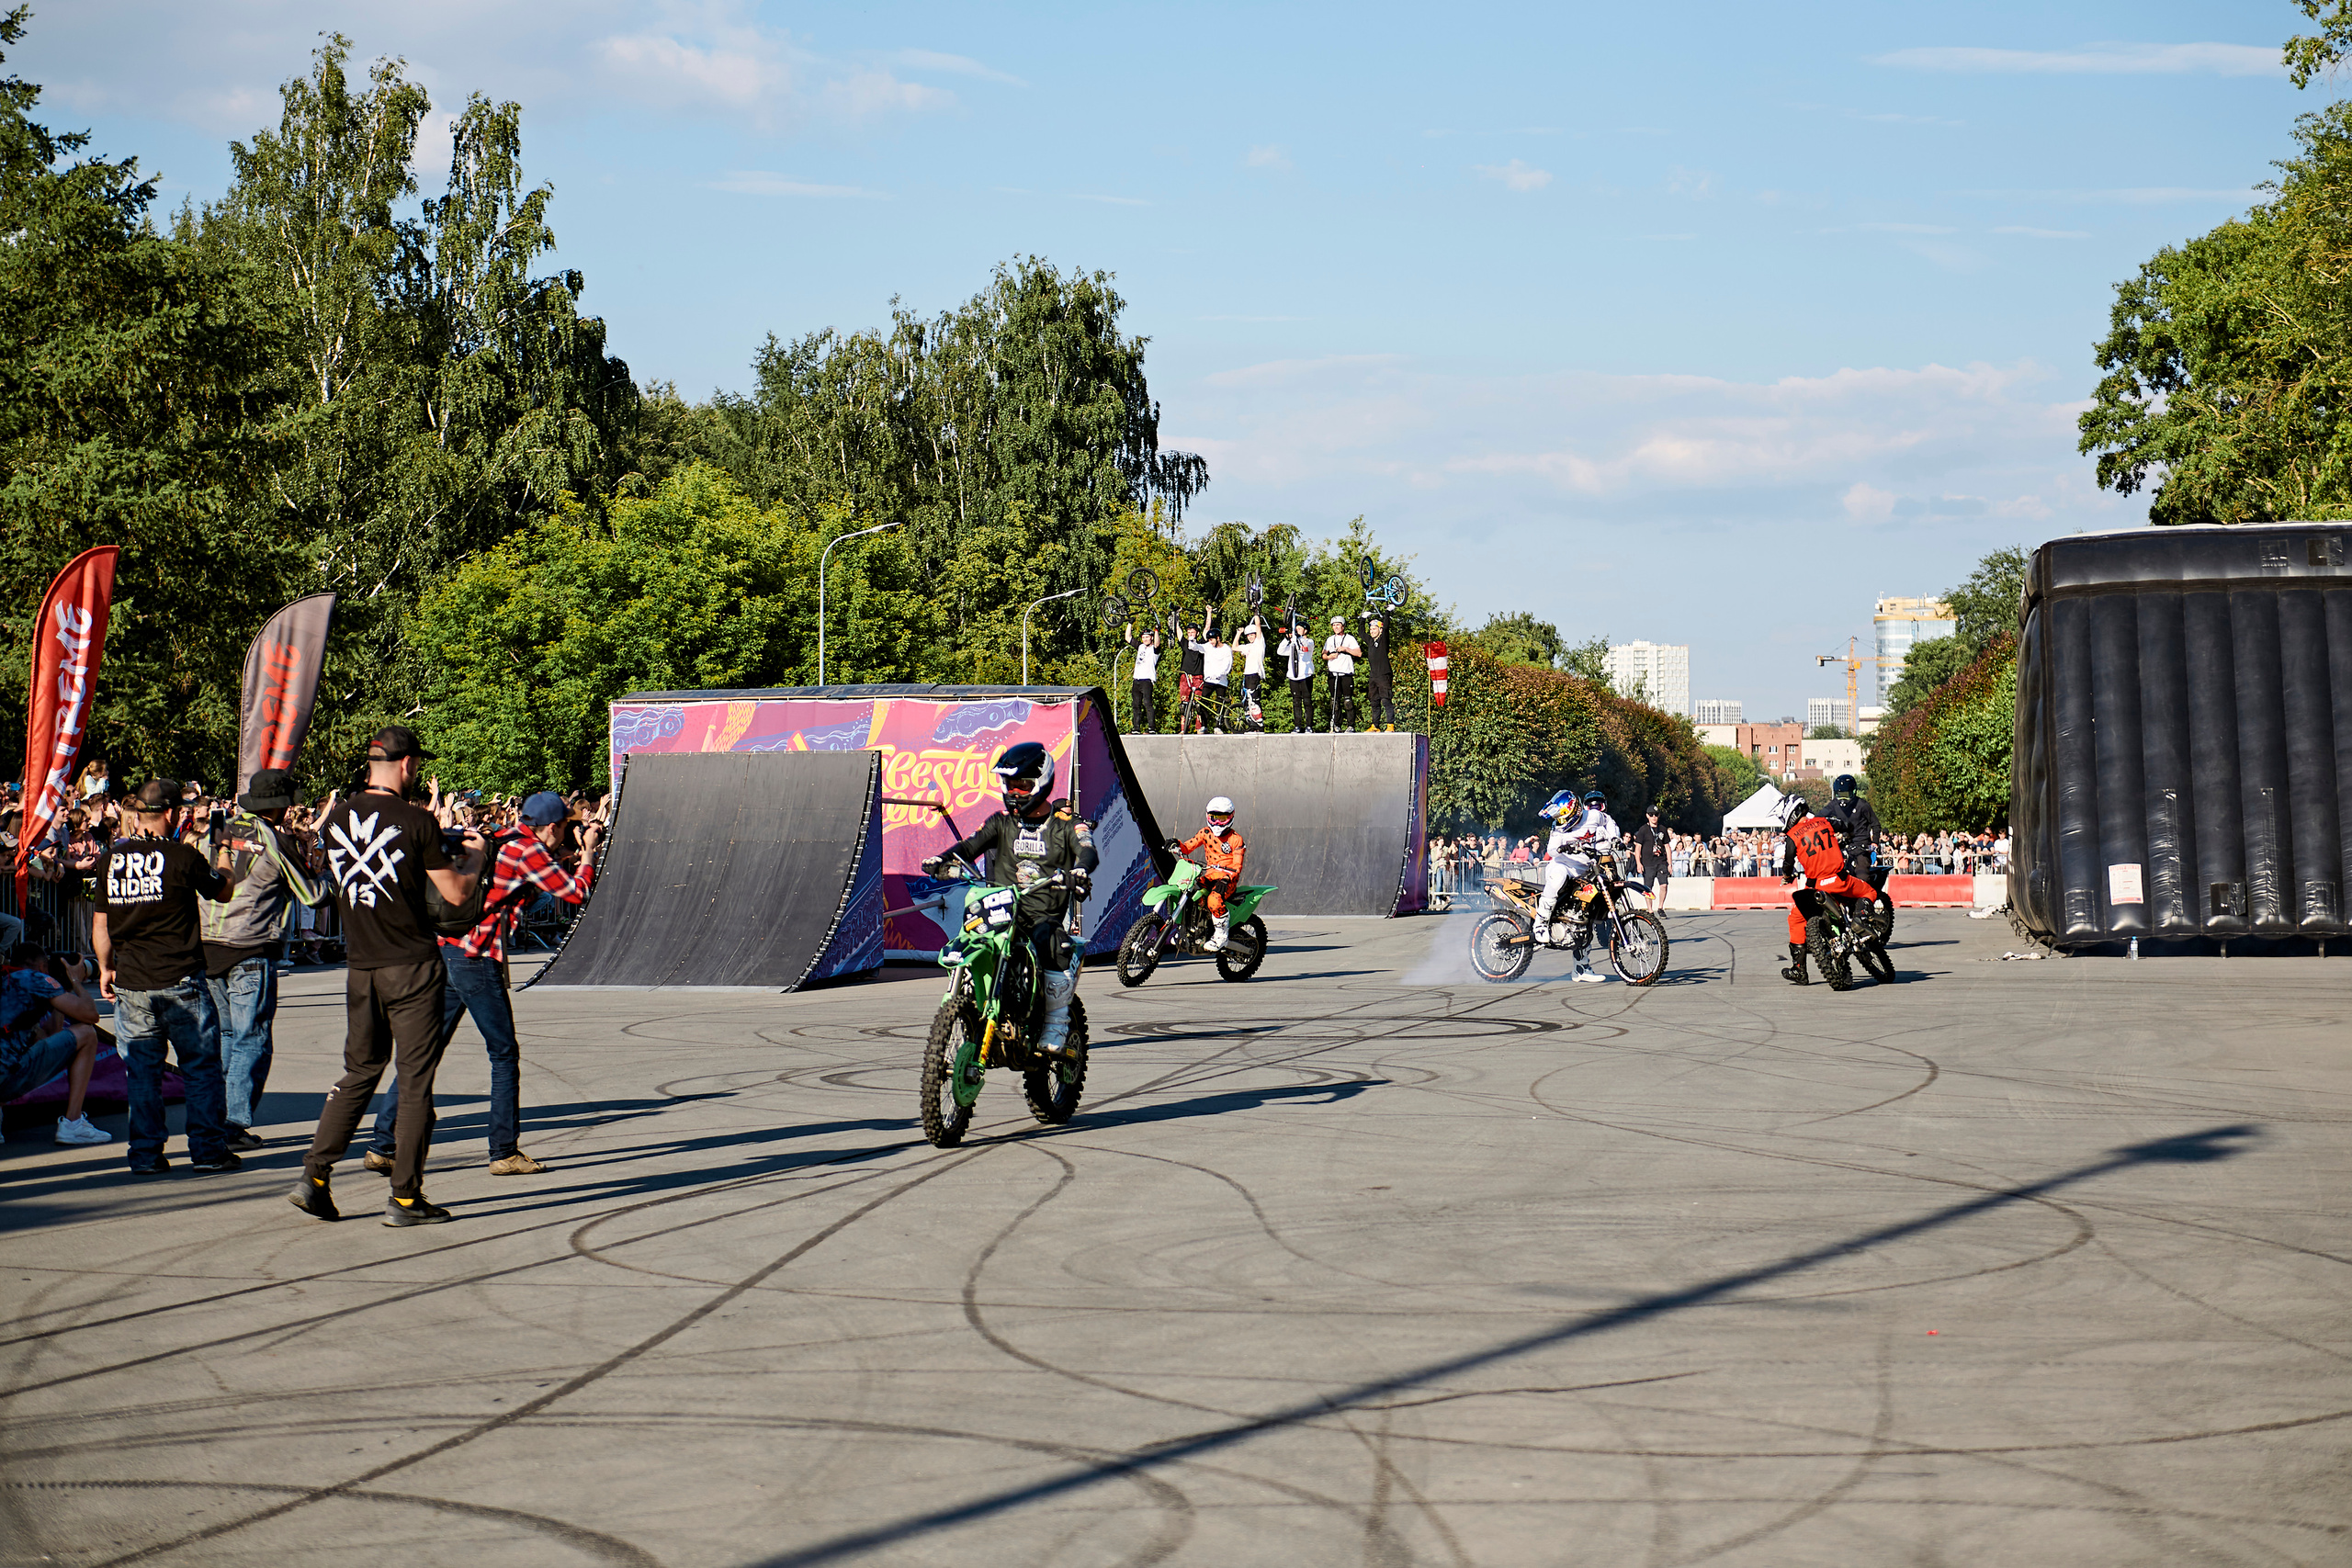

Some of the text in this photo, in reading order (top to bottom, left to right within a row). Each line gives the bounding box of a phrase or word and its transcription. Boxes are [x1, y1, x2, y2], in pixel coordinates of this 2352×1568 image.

[259, 639, 301, 770] TREME
[1014, 840, 1044, 852] GORILLA
[1801, 828, 1833, 858] 247
[107, 851, 164, 878] PRO
[107, 875, 163, 897] RIDER
[982, 889, 1012, 909] 102
